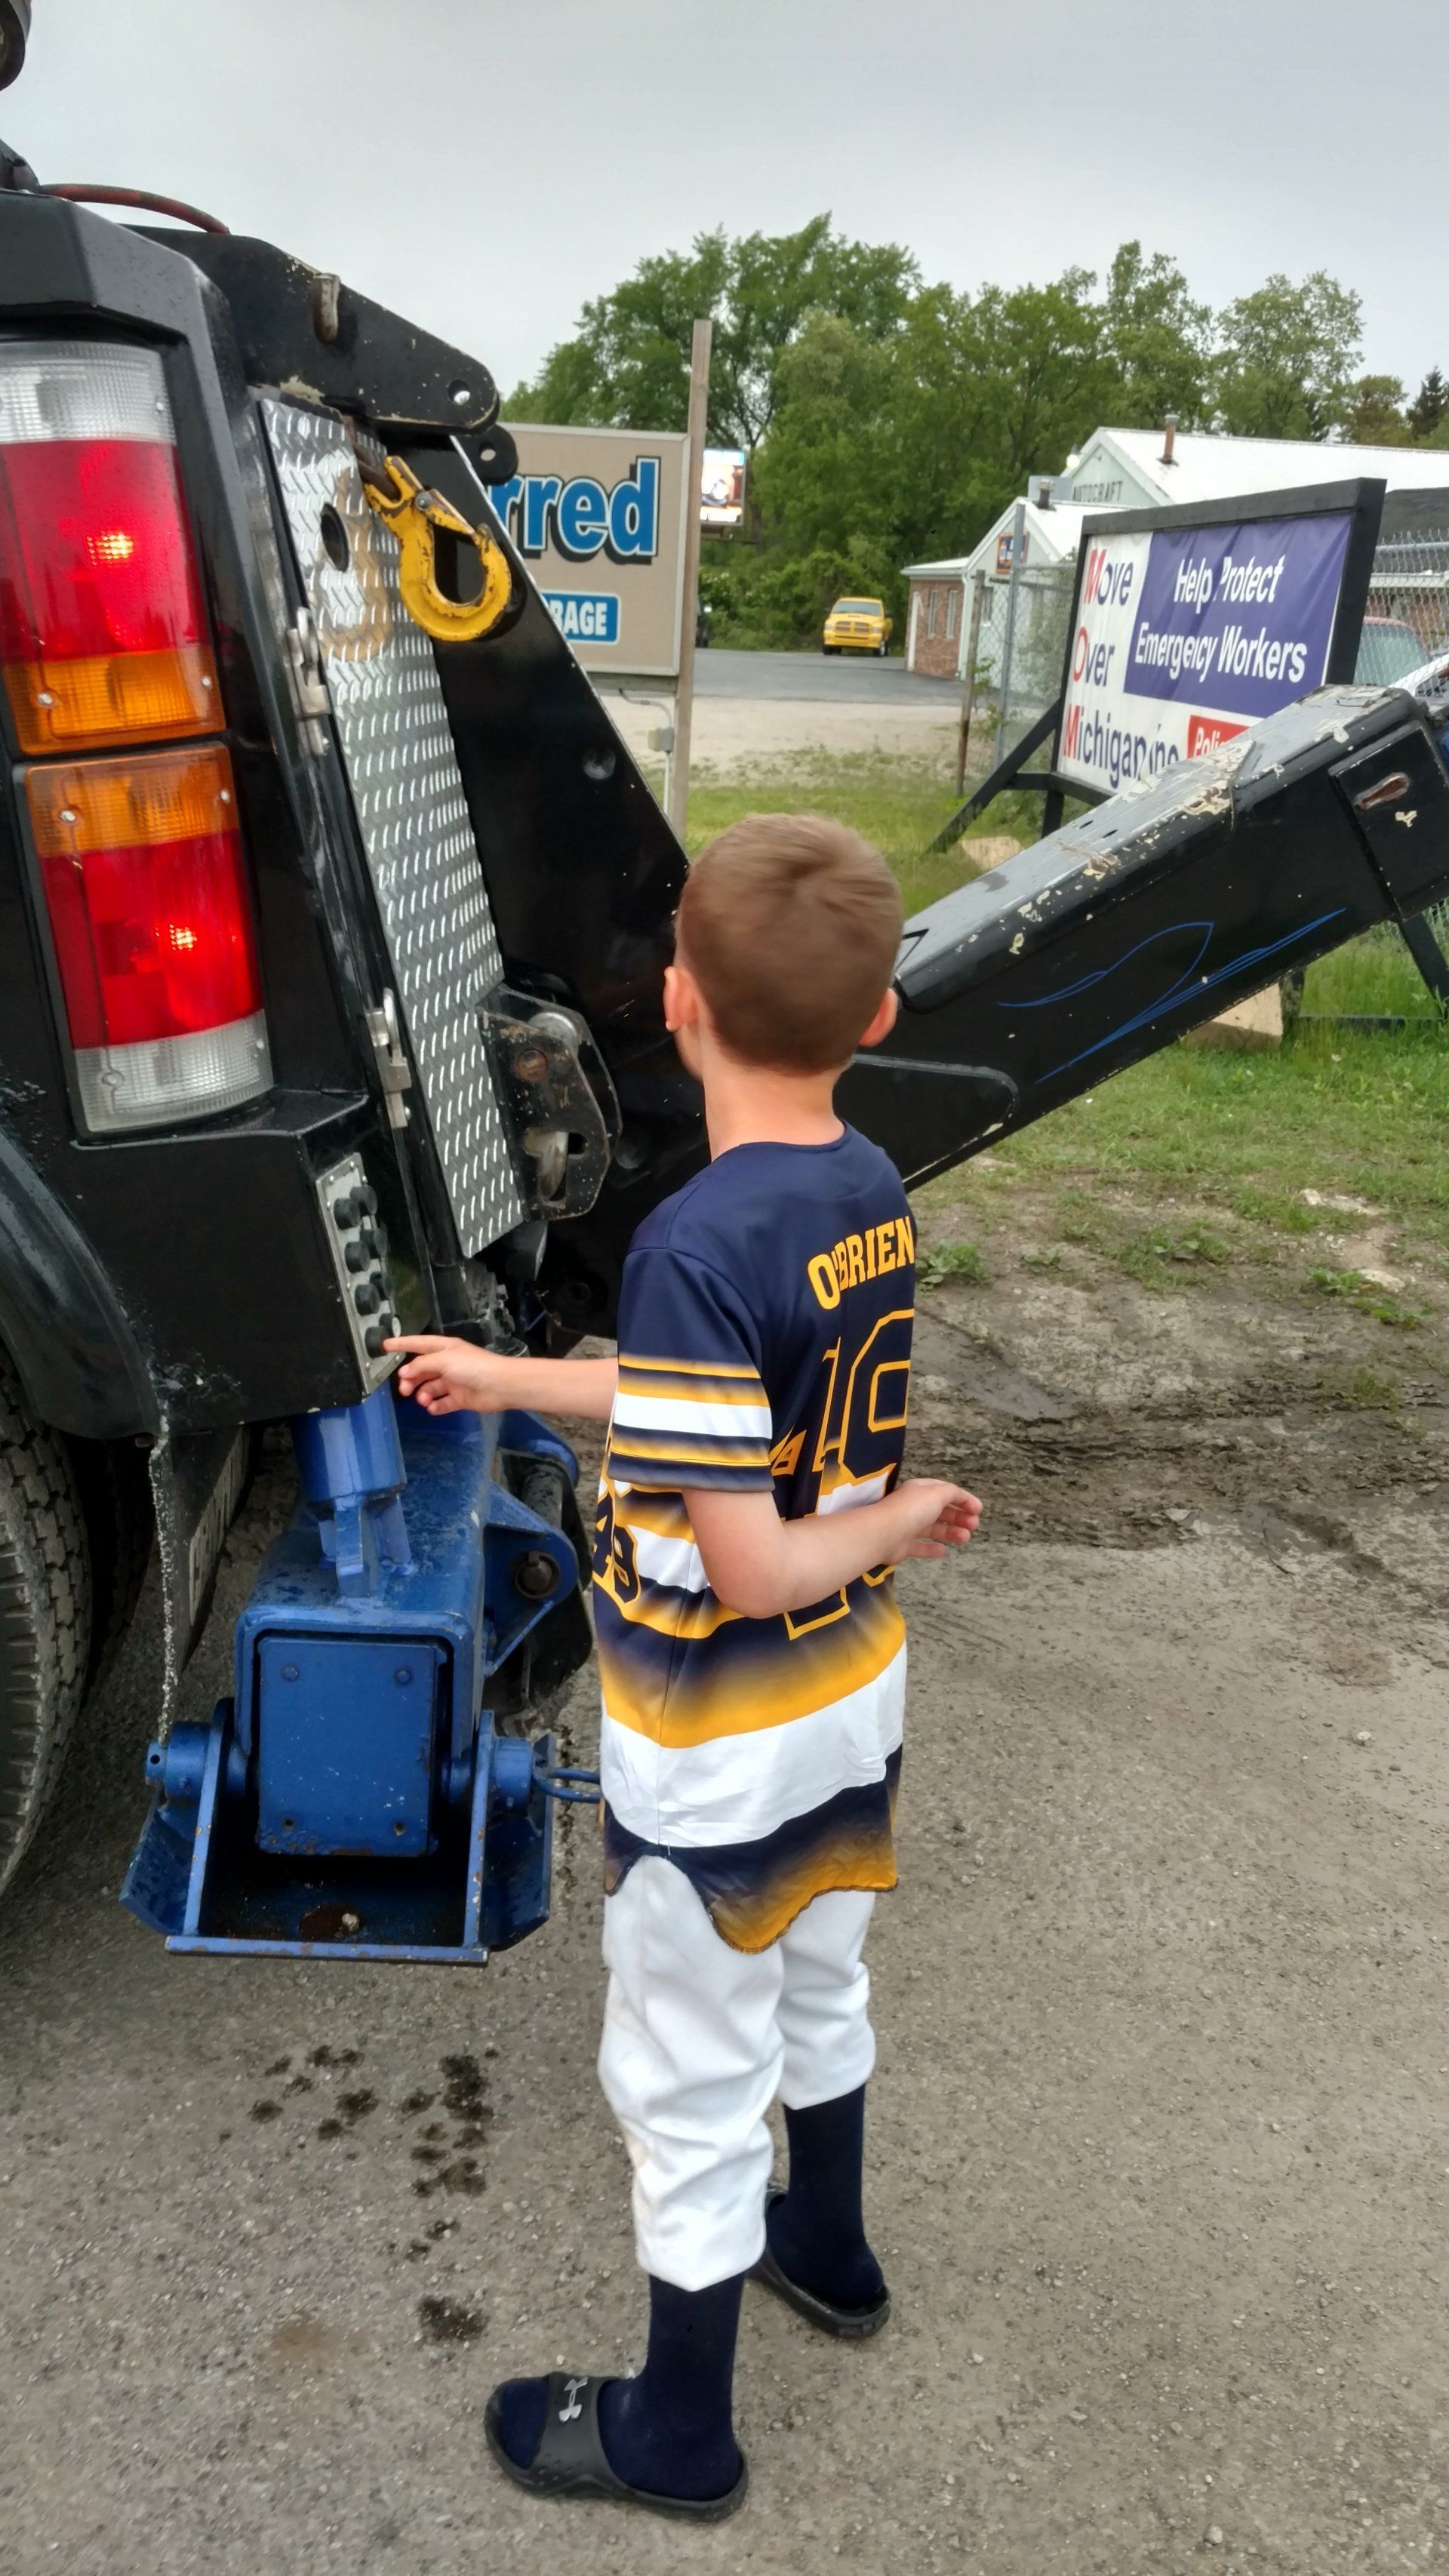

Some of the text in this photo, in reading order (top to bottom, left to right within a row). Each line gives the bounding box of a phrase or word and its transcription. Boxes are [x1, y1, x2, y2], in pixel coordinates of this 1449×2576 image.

[1084, 549, 1134, 606] Move
[1174, 555, 1286, 614] Help Protect
[1072, 626, 1115, 687] Over
[1217, 625, 1308, 683] Workers
[1063, 703, 1147, 789] Michigan
[1193, 726, 1224, 757] Poli
